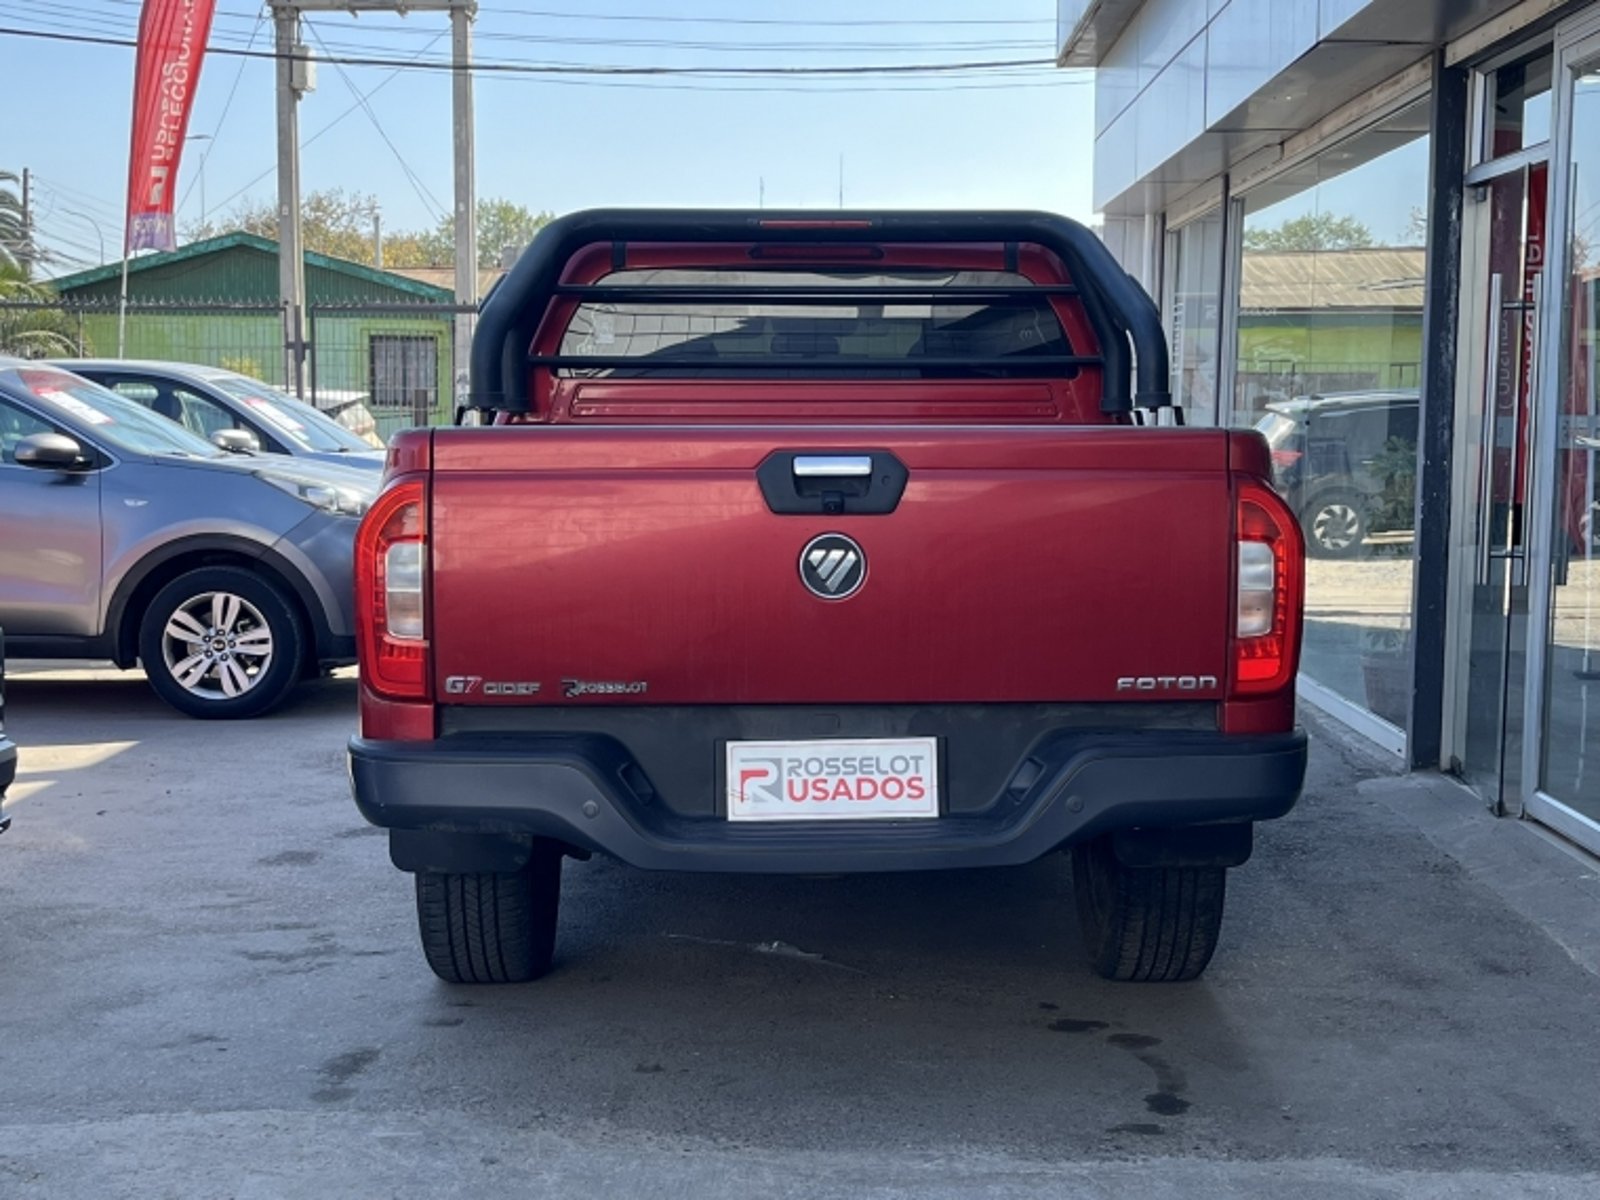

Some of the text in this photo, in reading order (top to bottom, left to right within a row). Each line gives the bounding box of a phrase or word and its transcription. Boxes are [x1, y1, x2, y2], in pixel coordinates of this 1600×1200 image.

[445, 675, 482, 694] G7
[1117, 675, 1217, 690] FOTON
[786, 755, 925, 777] ROSSELOT
[786, 776, 926, 803] USADOS
